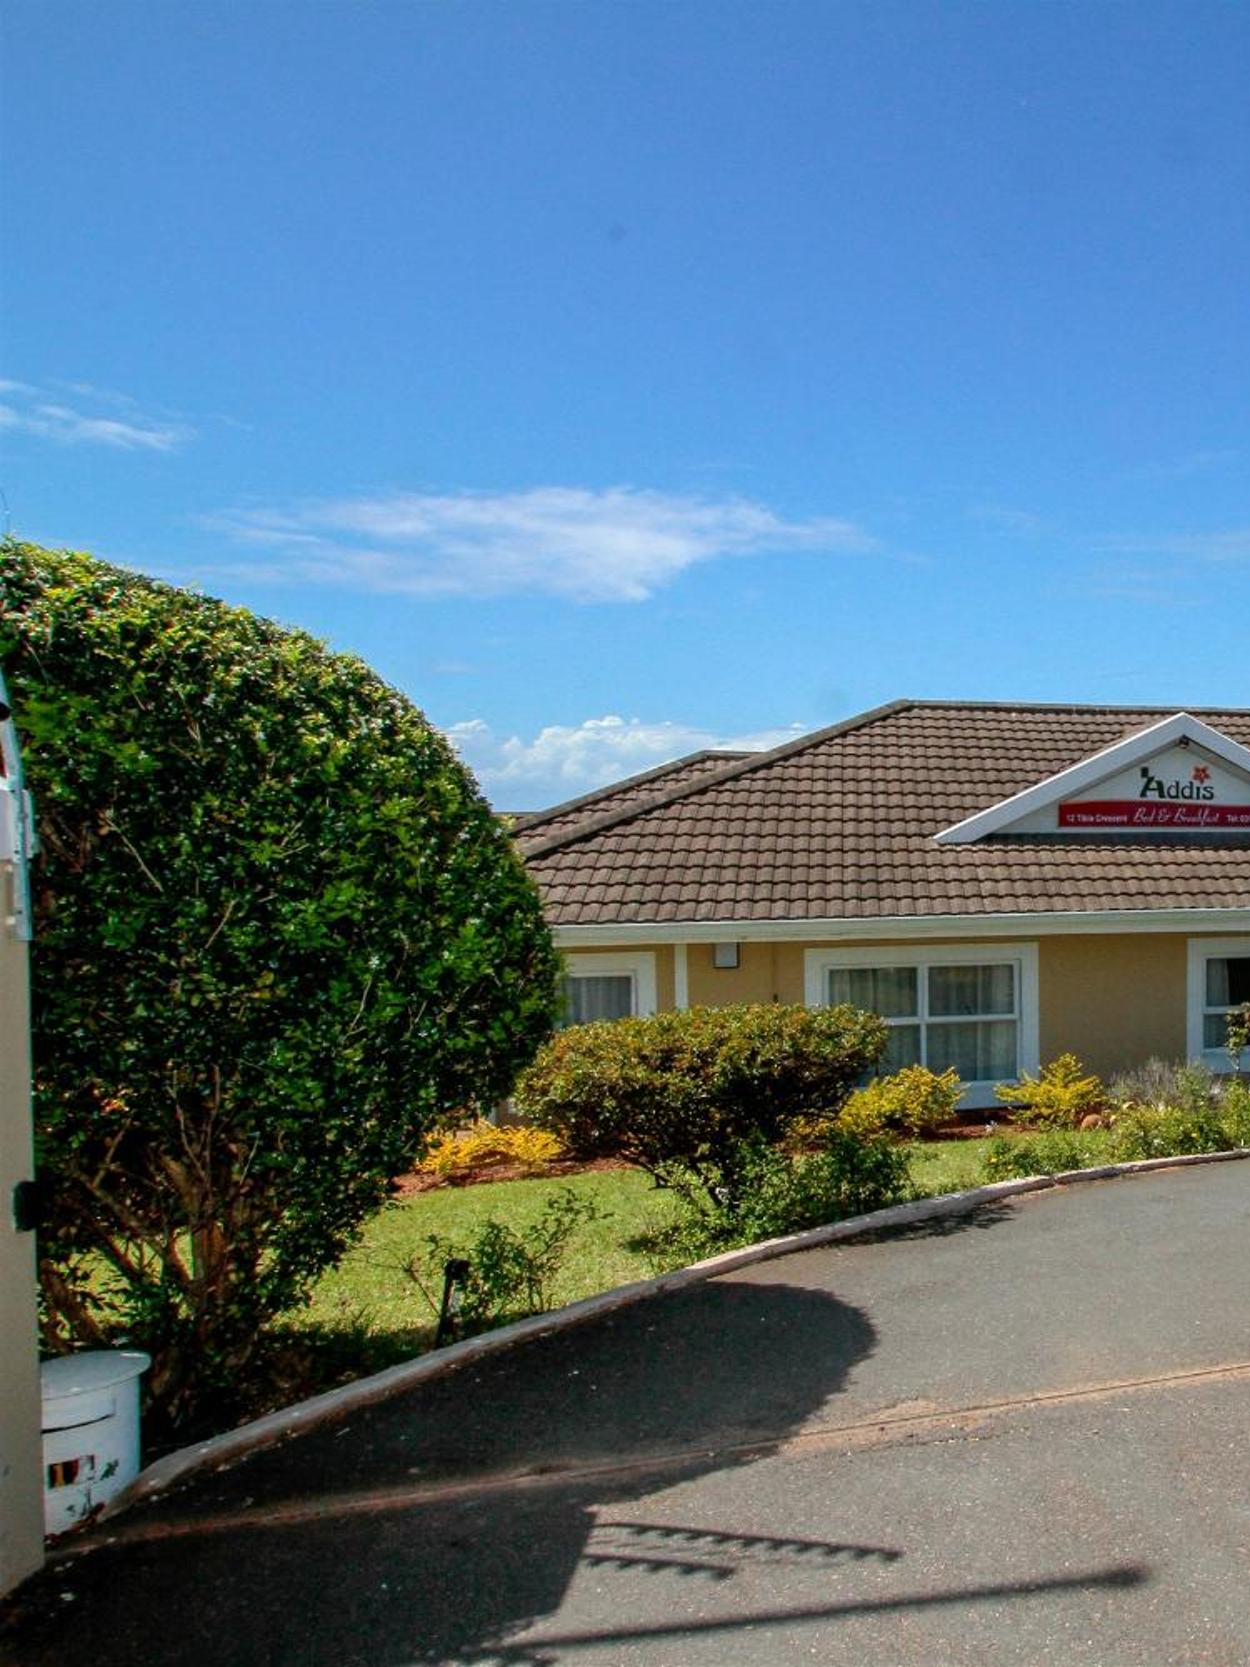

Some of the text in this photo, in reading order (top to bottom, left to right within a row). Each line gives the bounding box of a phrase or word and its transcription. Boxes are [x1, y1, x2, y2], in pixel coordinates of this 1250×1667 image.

[1139, 766, 1214, 800] Addis
[1133, 806, 1220, 826] Bed & Breakfast
